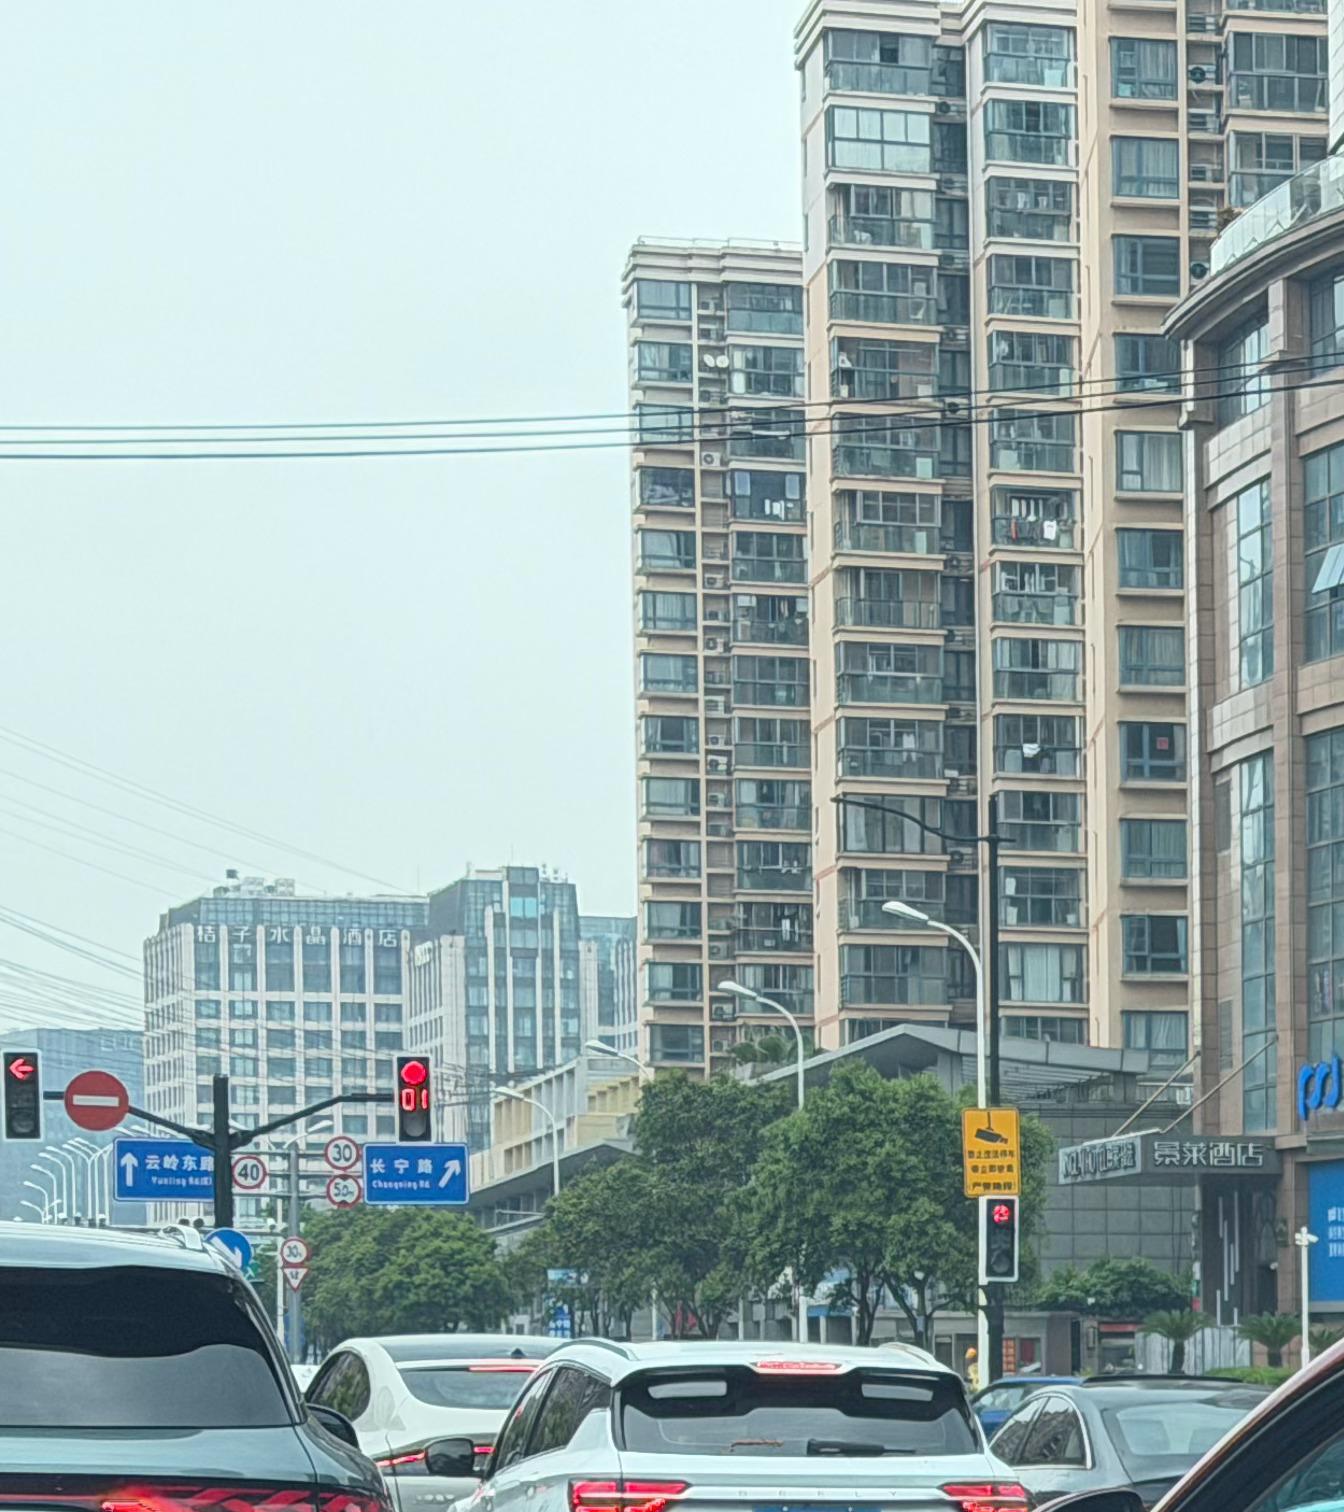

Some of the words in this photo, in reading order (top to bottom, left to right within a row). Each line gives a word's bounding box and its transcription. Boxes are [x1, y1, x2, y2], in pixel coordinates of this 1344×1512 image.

[332, 1144, 353, 1162] 30
[1153, 1141, 1264, 1167] 景莱酒店
[145, 1154, 214, 1172] 云岭东路
[238, 1163, 260, 1181] 40
[370, 1158, 433, 1174] 长宁路
